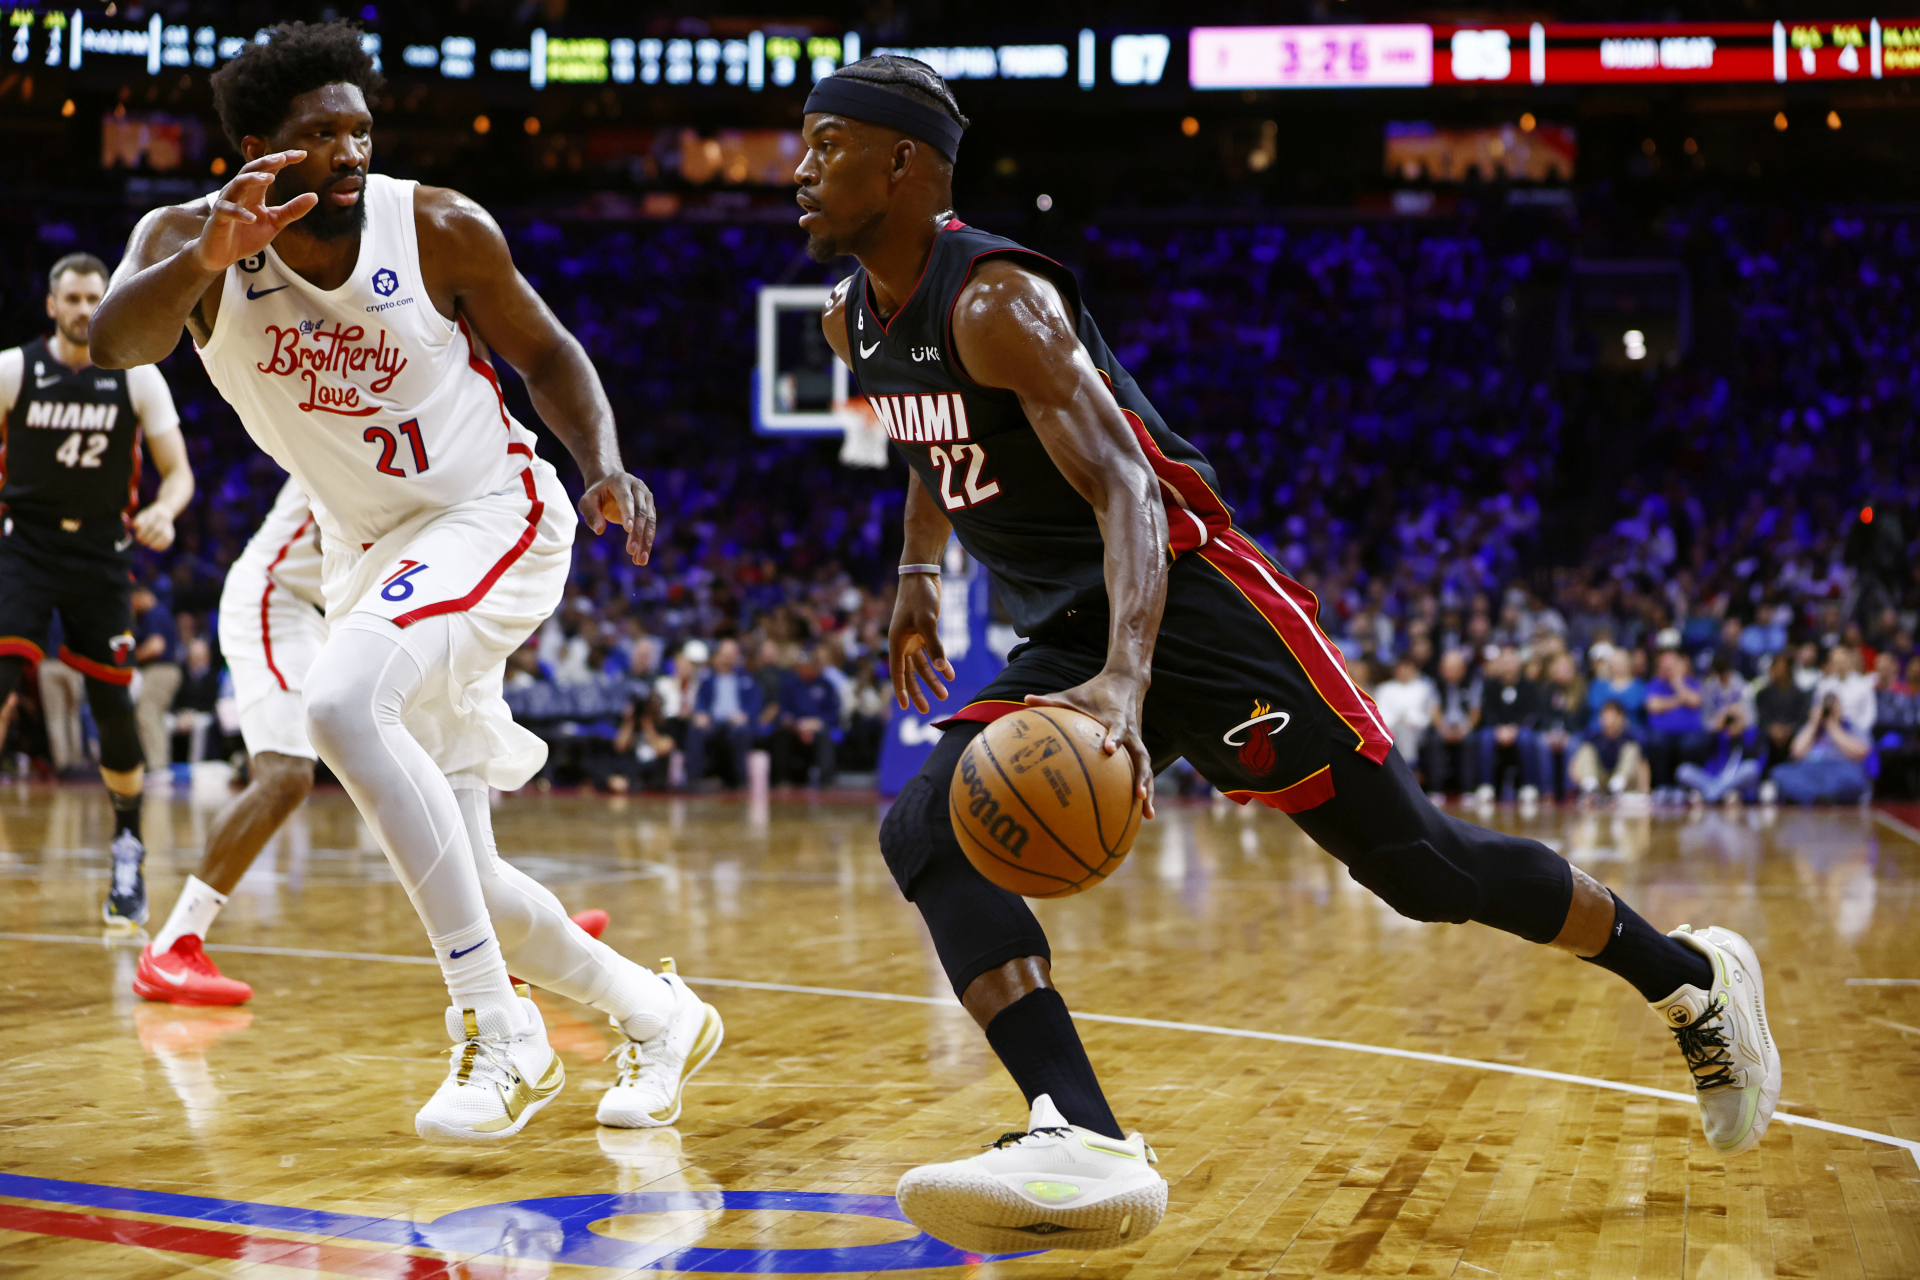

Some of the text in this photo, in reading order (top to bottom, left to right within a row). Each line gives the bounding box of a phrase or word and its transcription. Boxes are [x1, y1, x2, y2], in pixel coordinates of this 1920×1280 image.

[365, 297, 414, 312] crypto.com
[857, 308, 864, 330] 6
[257, 322, 408, 393] Brotherly
[26, 401, 118, 431] MIAMI
[298, 370, 383, 417] Love
[867, 392, 970, 443] MIAMI
[56, 432, 109, 468] 42
[363, 417, 430, 478] 21
[928, 442, 1003, 513] 22
[960, 745, 1030, 859] Wilson
